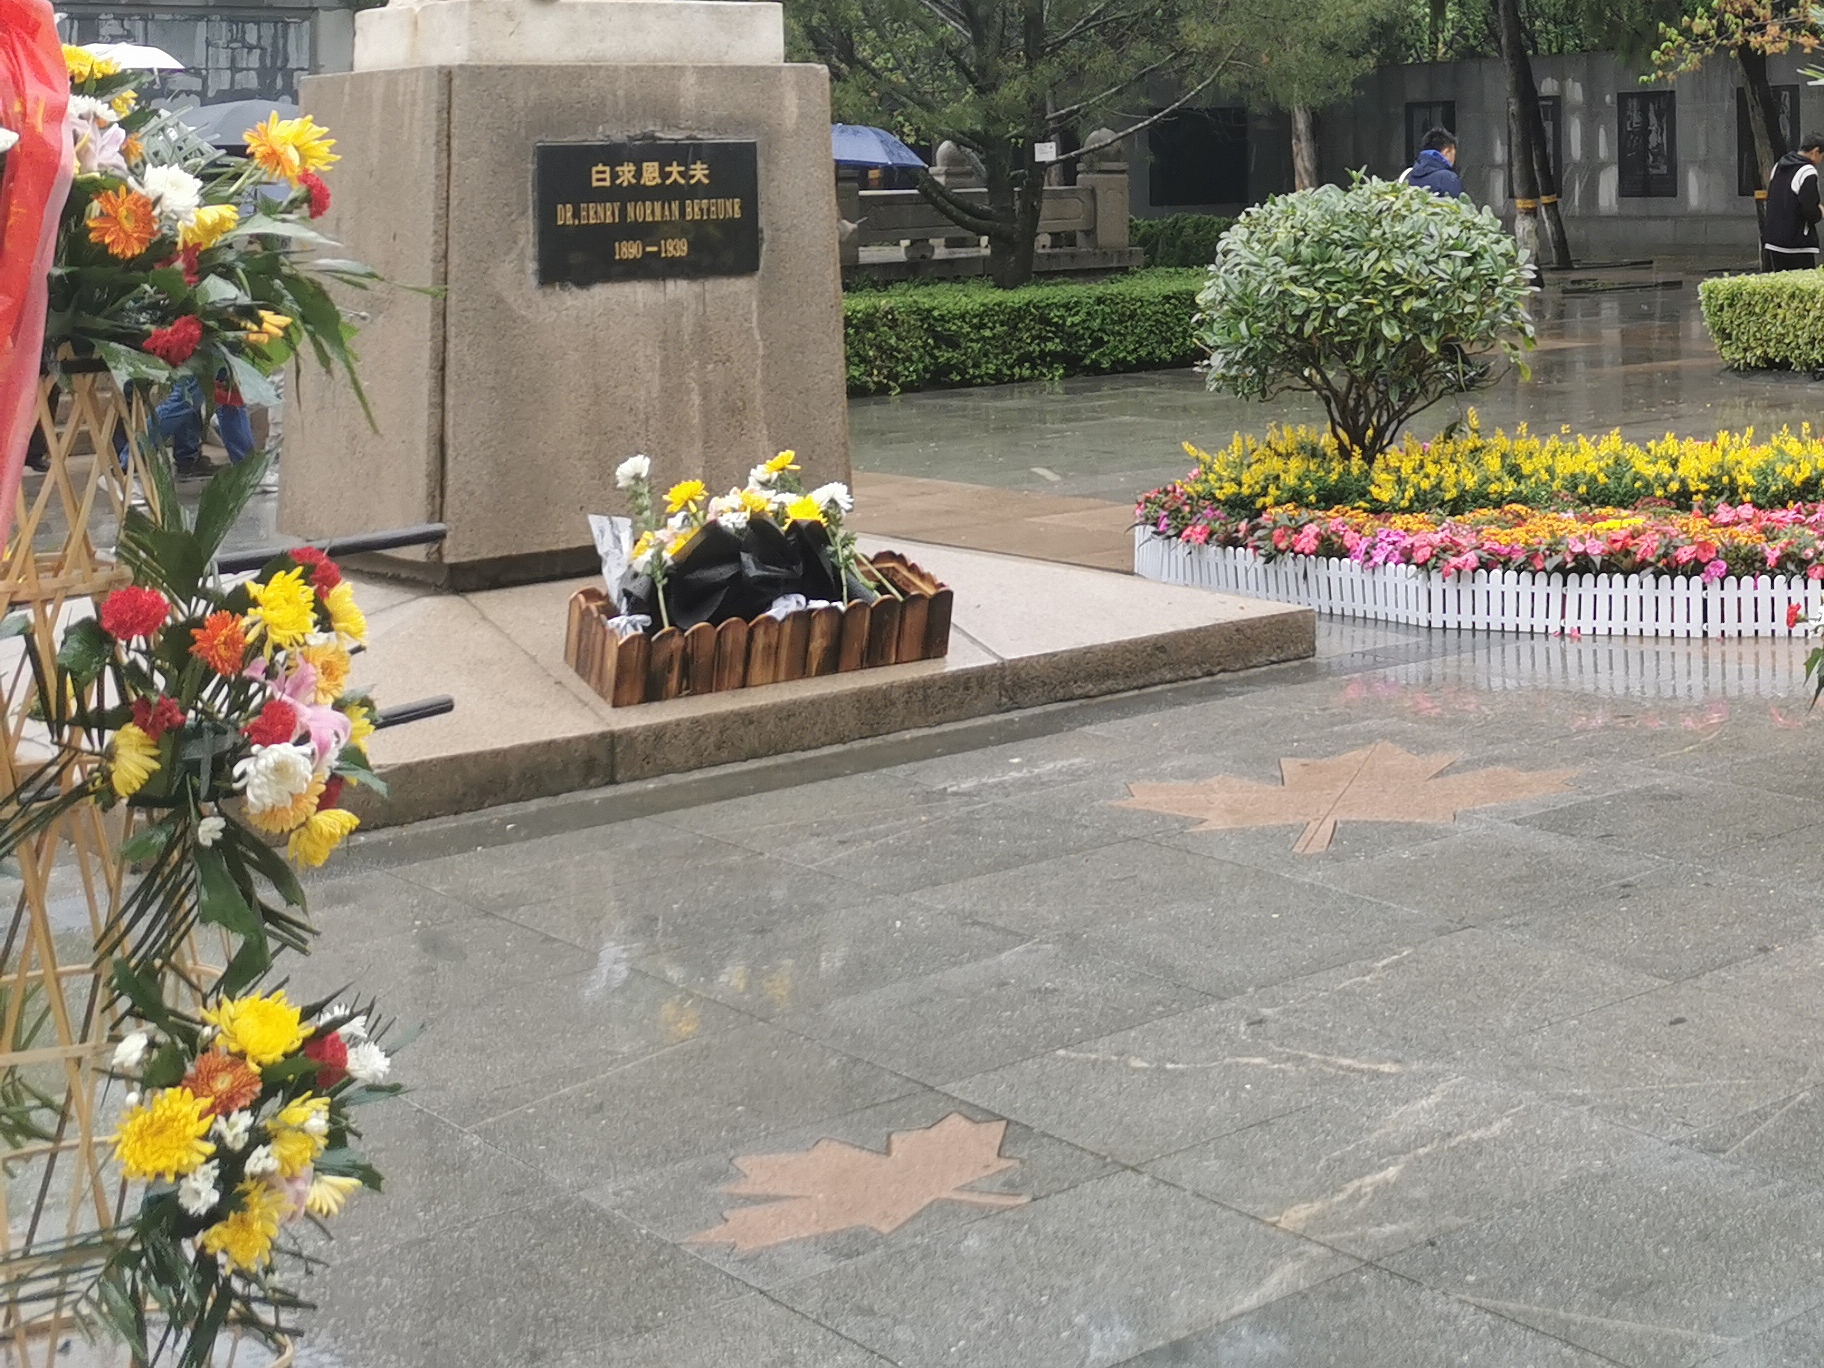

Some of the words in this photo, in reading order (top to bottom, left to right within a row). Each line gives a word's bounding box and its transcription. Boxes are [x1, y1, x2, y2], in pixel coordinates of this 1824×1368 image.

[590, 160, 710, 188] 白求恩大夫
[626, 199, 680, 223] NORMAN
[685, 197, 742, 221] BETHUNE
